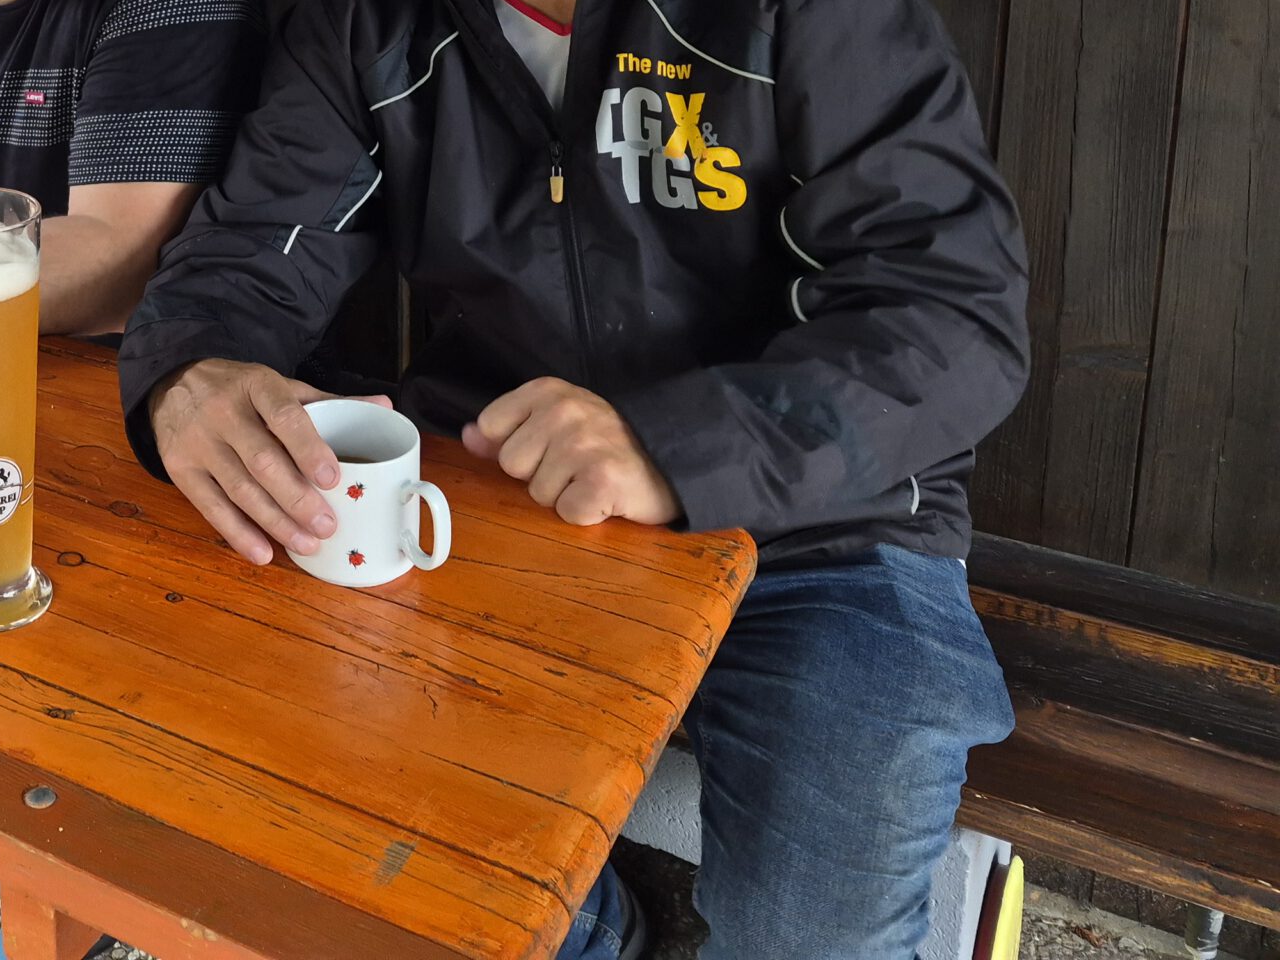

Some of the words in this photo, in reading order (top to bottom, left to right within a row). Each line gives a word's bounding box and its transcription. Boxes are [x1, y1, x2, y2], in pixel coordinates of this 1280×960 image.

[616, 53, 651, 74] The
[657, 60, 692, 80] new
[702, 121, 719, 146] &
[611, 141, 747, 211] TGS
